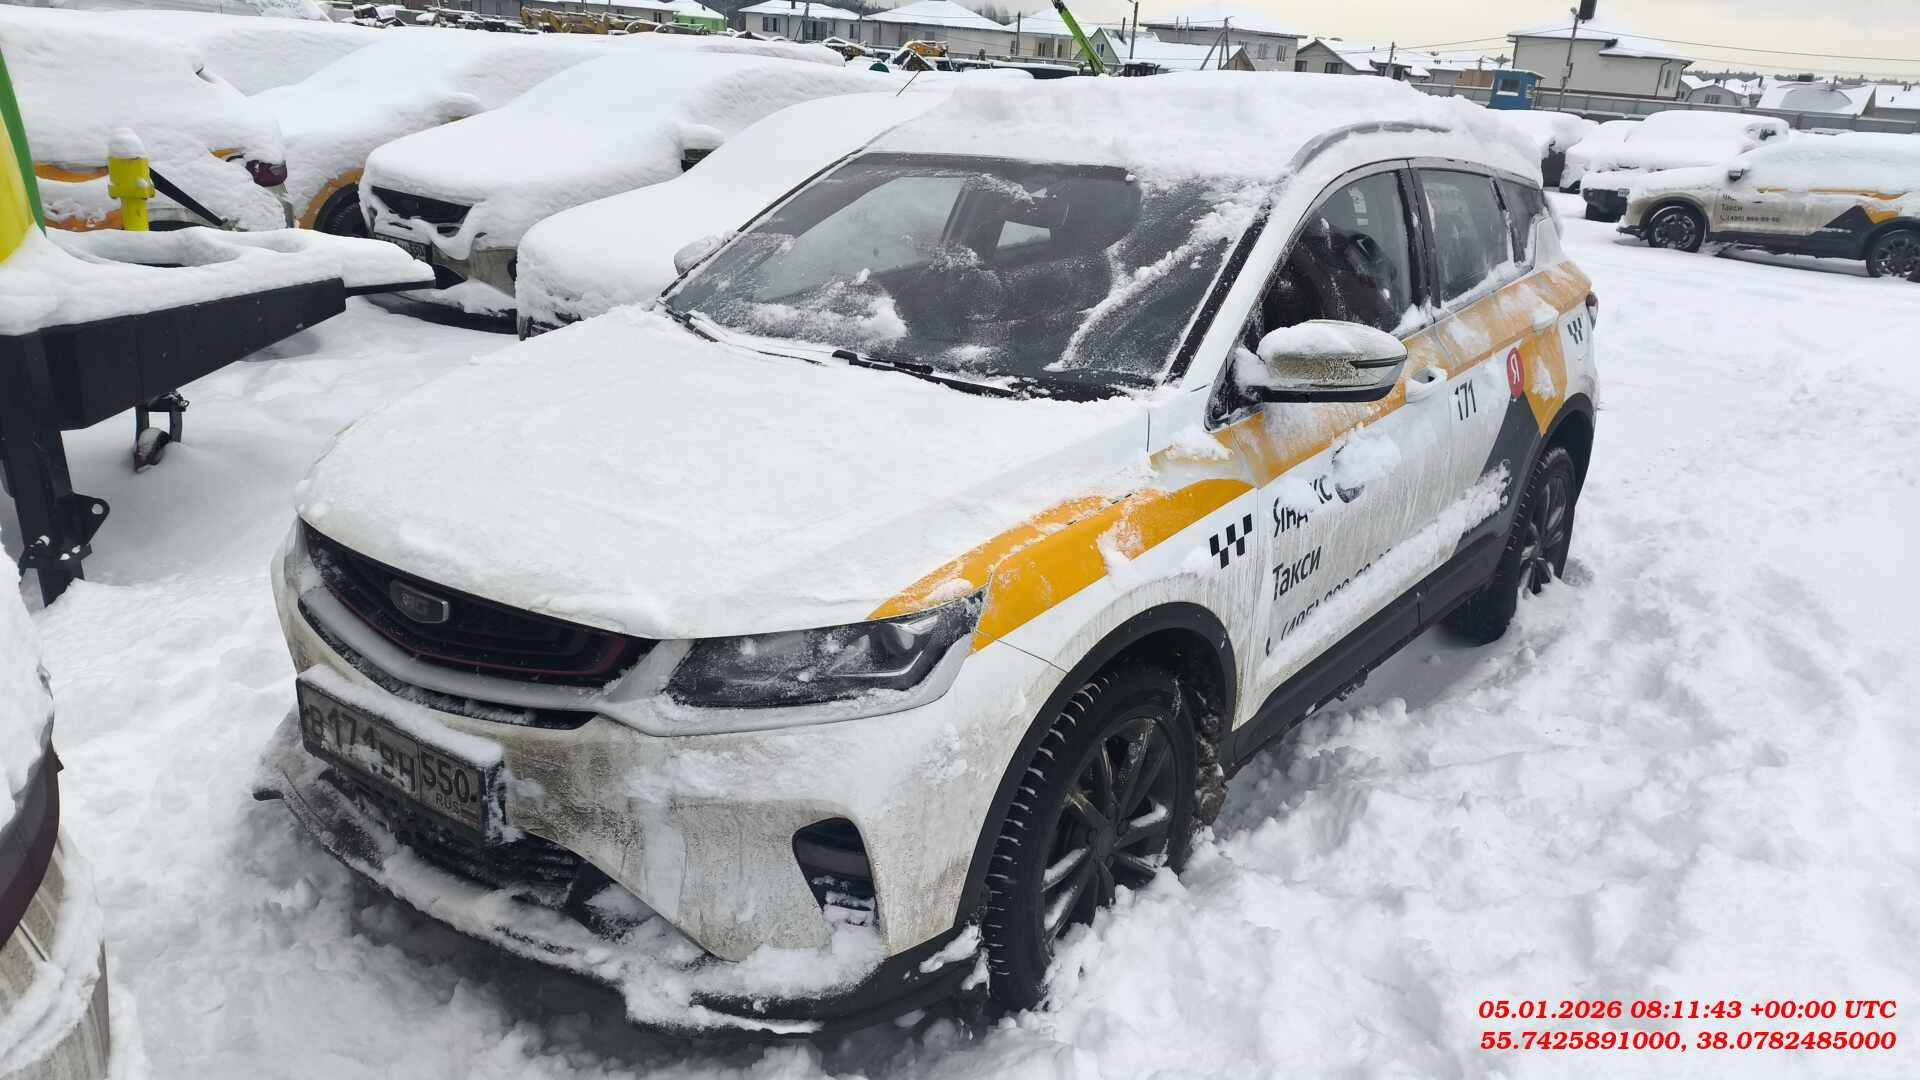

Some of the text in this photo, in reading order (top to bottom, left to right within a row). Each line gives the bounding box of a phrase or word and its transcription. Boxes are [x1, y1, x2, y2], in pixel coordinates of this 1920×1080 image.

[1454, 379, 1476, 421] 171
[1272, 545, 1322, 601] Такси
[421, 752, 472, 803] 550
[435, 792, 462, 814] RUS
